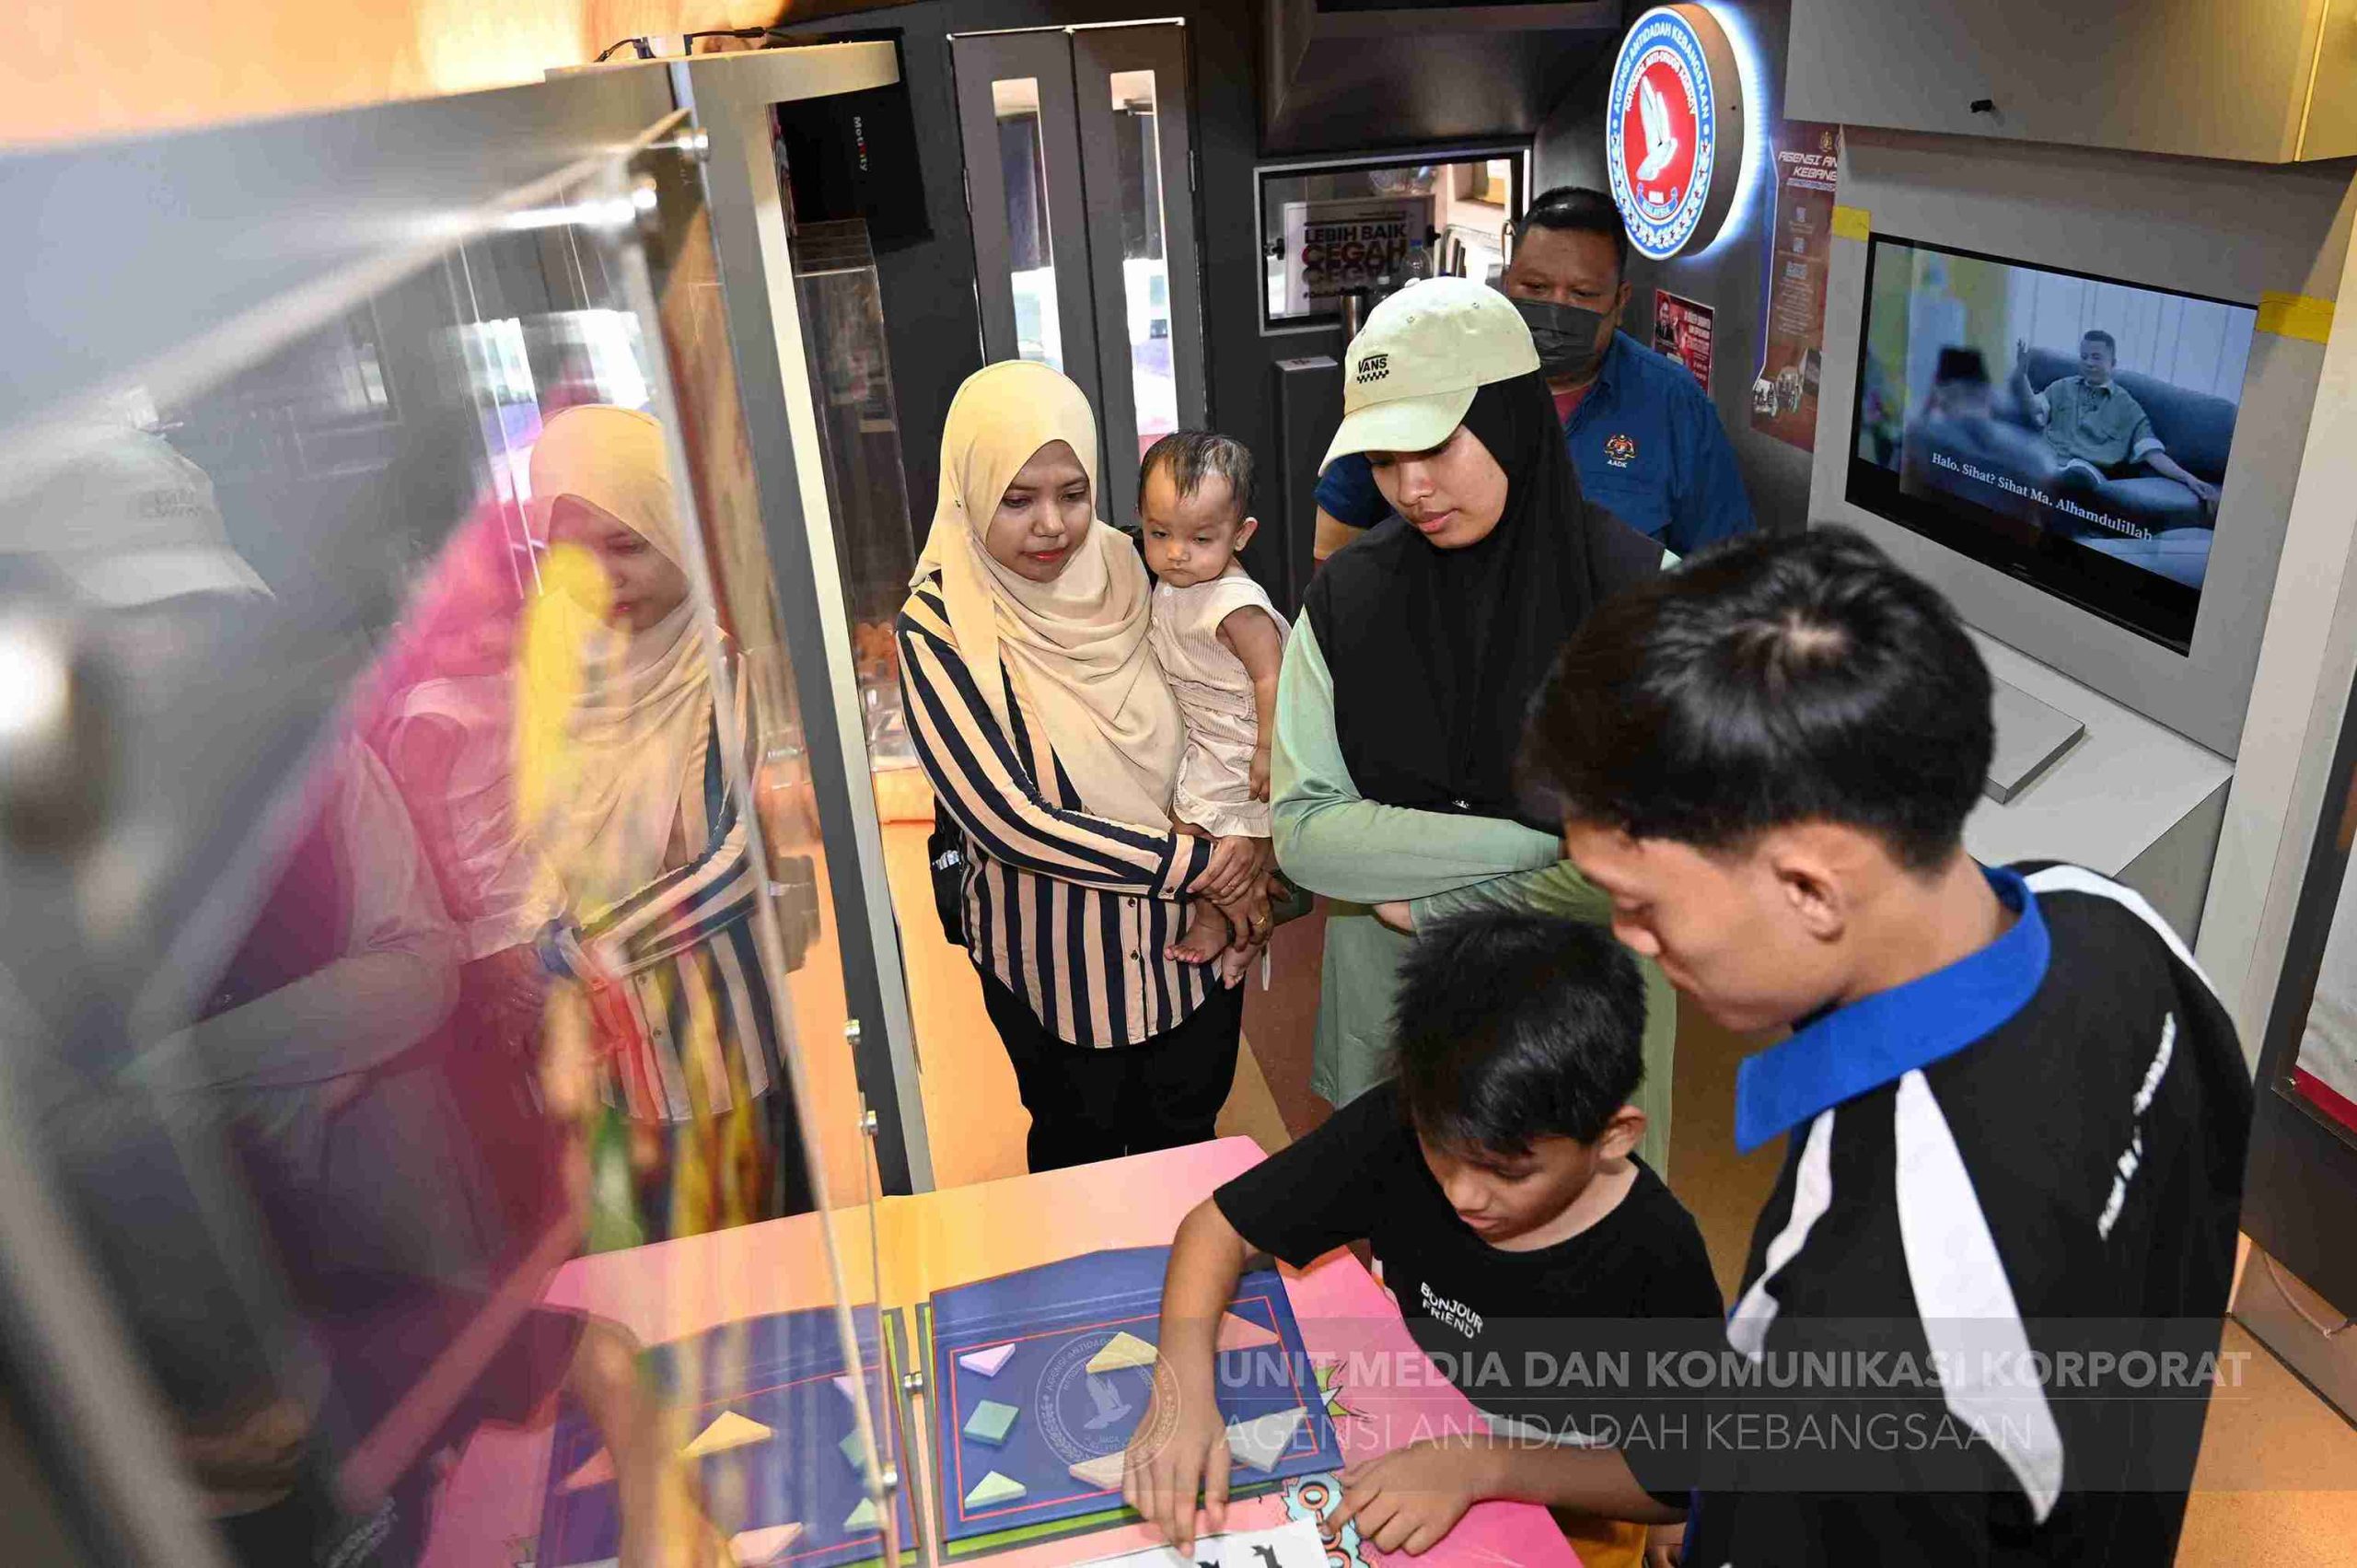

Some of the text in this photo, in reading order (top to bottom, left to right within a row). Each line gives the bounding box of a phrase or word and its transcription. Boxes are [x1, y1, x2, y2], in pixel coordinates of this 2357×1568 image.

[1778, 151, 1822, 166] AGENSI
[1304, 222, 1408, 244] LEBIH BAIK
[1301, 239, 1408, 266] CEGAH
[1358, 354, 1388, 374] VANS
[1932, 452, 2153, 542] Halo. Sihat? Sihat Ma. Alhamdulillah
[1421, 1281, 1484, 1334] BONJOUR
[1422, 1297, 1474, 1340] FRIEND
